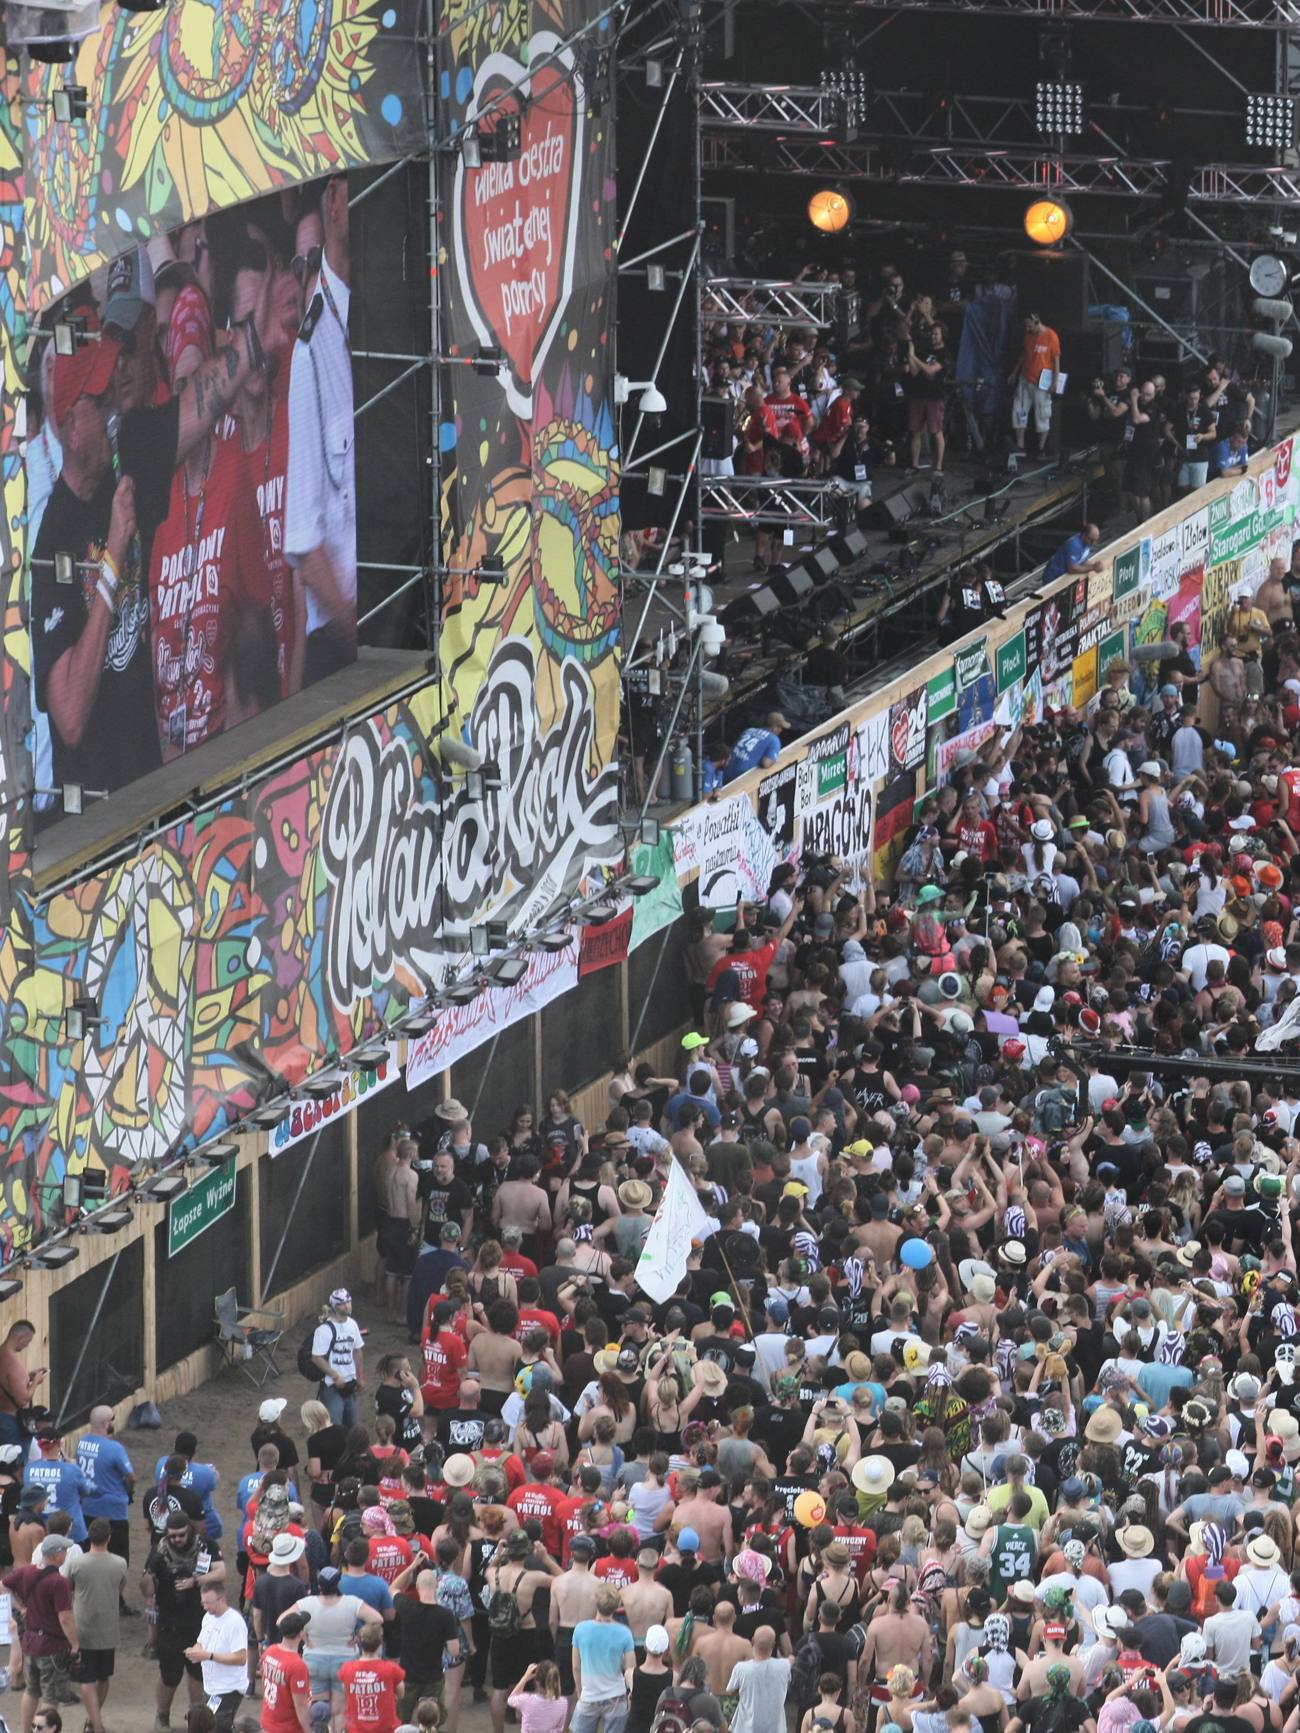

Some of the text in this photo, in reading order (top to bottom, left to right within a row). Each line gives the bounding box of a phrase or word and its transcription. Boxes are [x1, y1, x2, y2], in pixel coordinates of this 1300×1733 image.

[1212, 523, 1250, 560] Starogard
[820, 758, 846, 783] Mirzec
[173, 1178, 234, 1236] Łapsze Wyżne
[78, 1439, 101, 1453] PATROL
[30, 1467, 62, 1478] PATROL
[517, 1502, 551, 1516] PATROL
[1005, 1541, 1026, 1552] PIERCE
[371, 1555, 406, 1568] PATROL
[999, 1552, 1031, 1578] 34
[350, 1682, 386, 1694] PATROL
